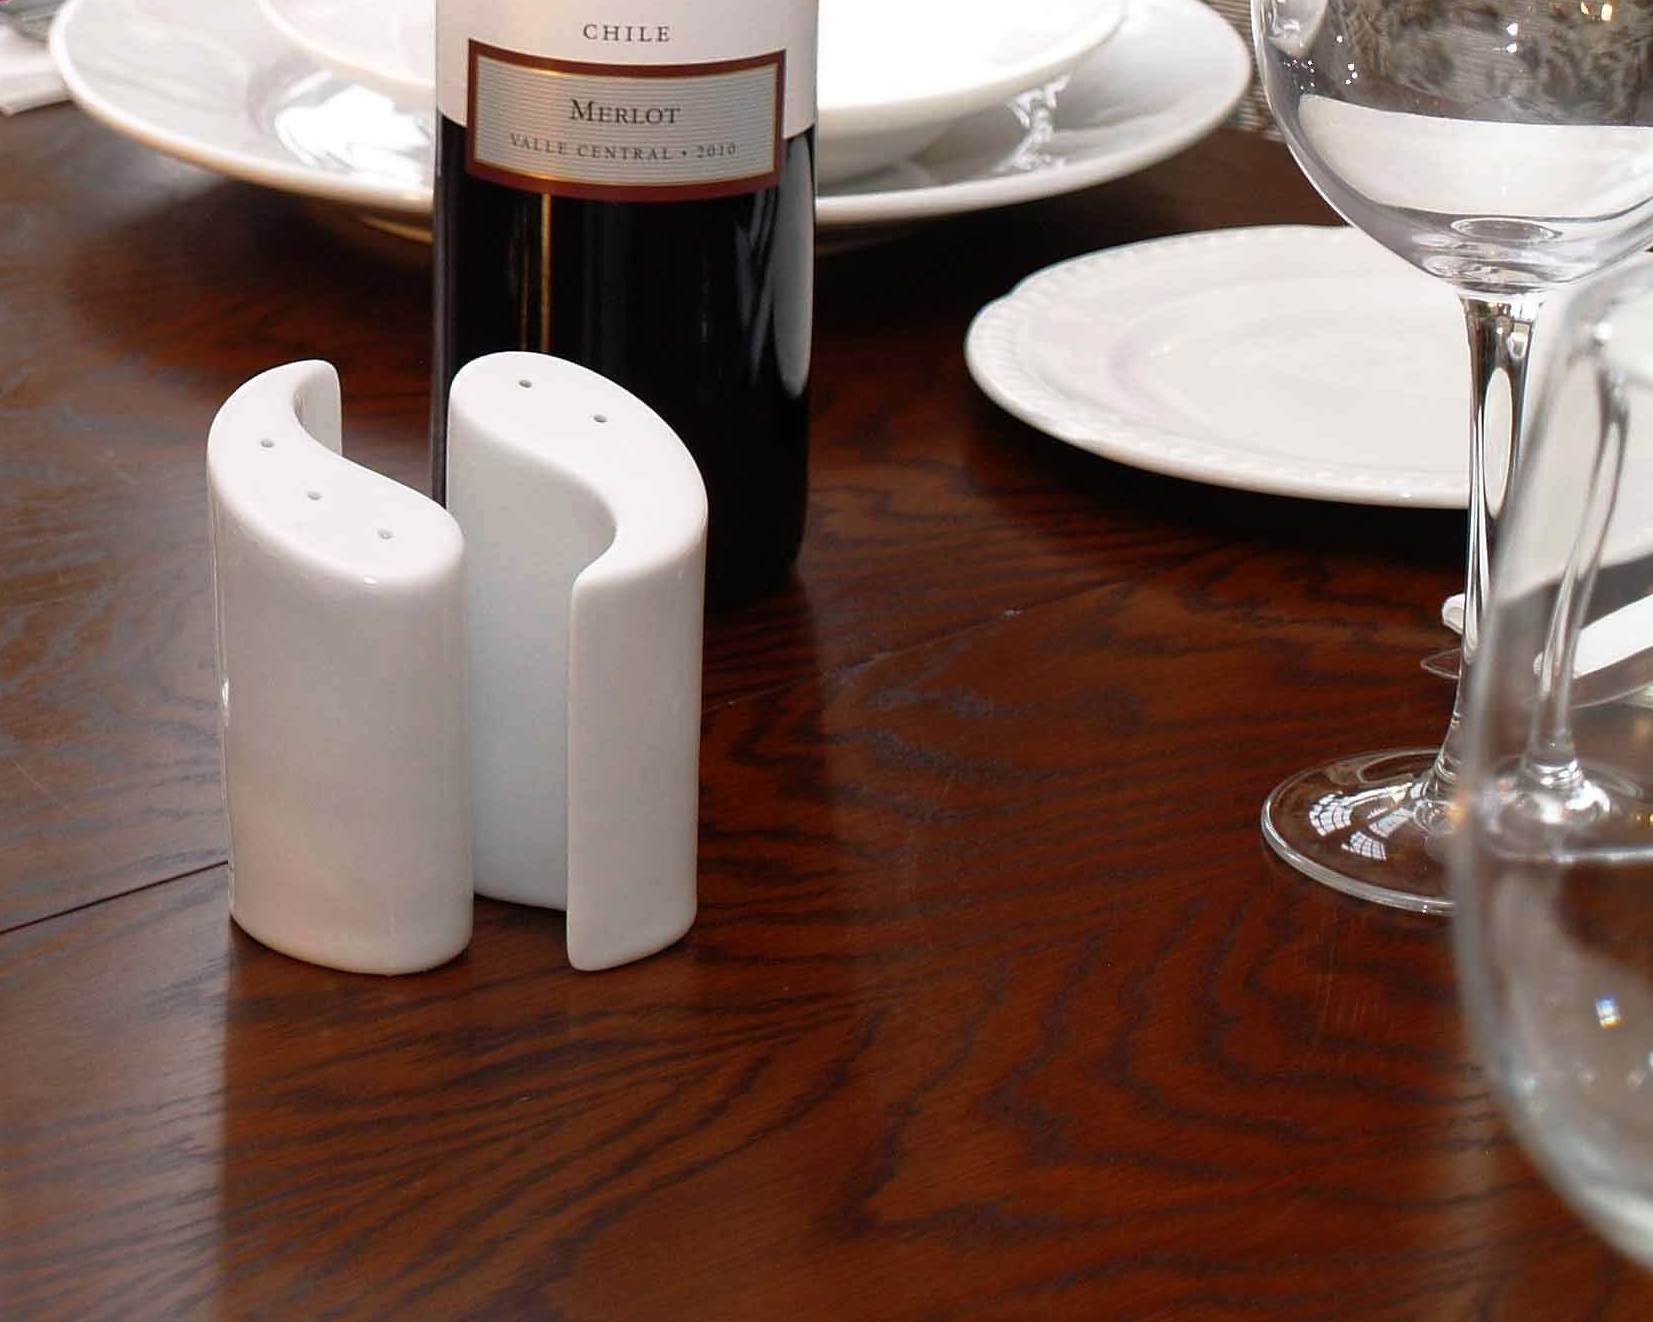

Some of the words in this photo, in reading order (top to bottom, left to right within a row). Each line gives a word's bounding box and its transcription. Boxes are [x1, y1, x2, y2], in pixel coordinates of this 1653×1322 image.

[583, 23, 671, 43] CHILE
[568, 98, 681, 125] MERLOT
[509, 132, 568, 156] VALLE
[577, 143, 672, 161] CENTRAL
[696, 141, 737, 159] 2010
